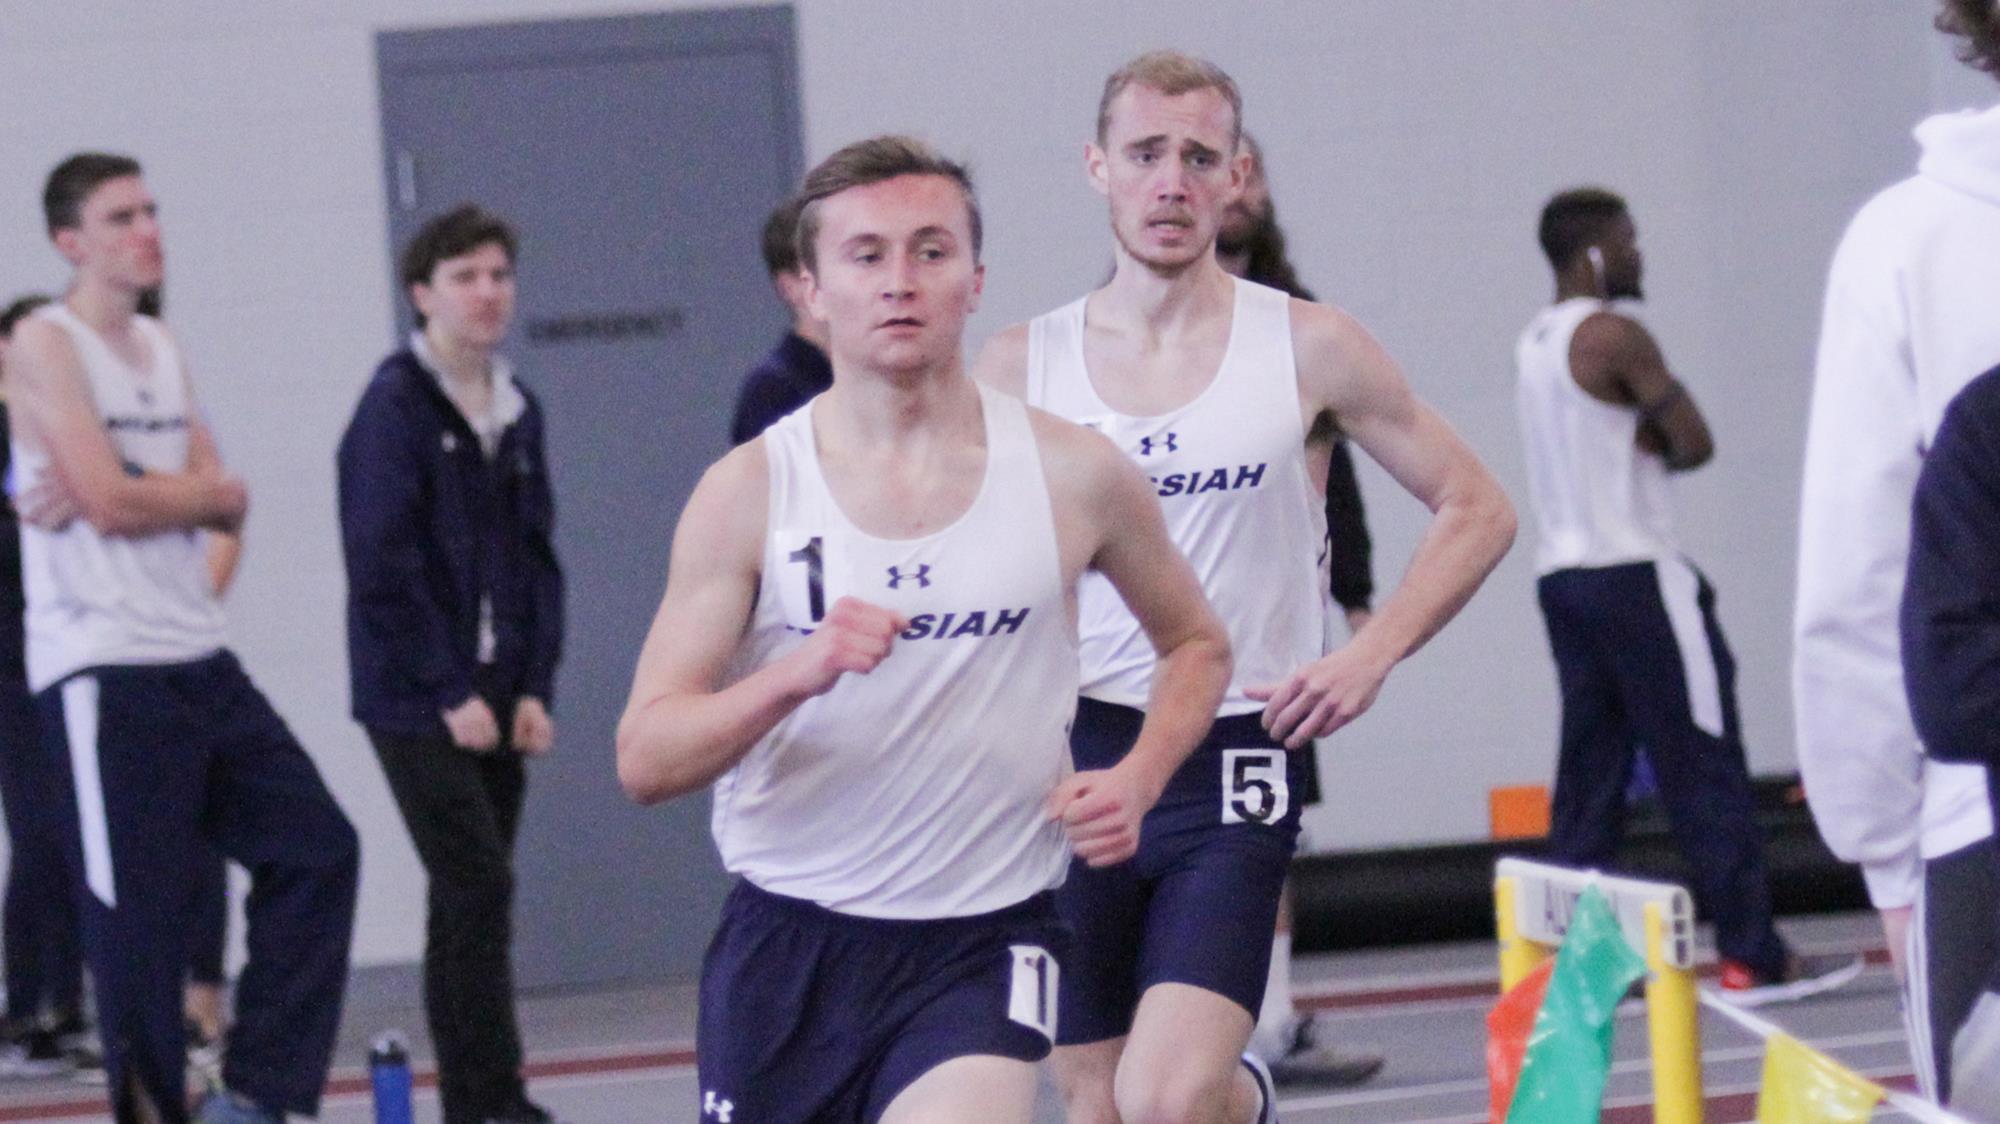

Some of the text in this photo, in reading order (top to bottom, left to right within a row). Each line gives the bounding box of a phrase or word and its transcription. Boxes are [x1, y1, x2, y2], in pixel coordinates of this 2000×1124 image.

[1150, 462, 1267, 497] SIAH
[788, 536, 825, 622] 1
[1231, 755, 1276, 824] 5
[1024, 954, 1047, 1026] 1
